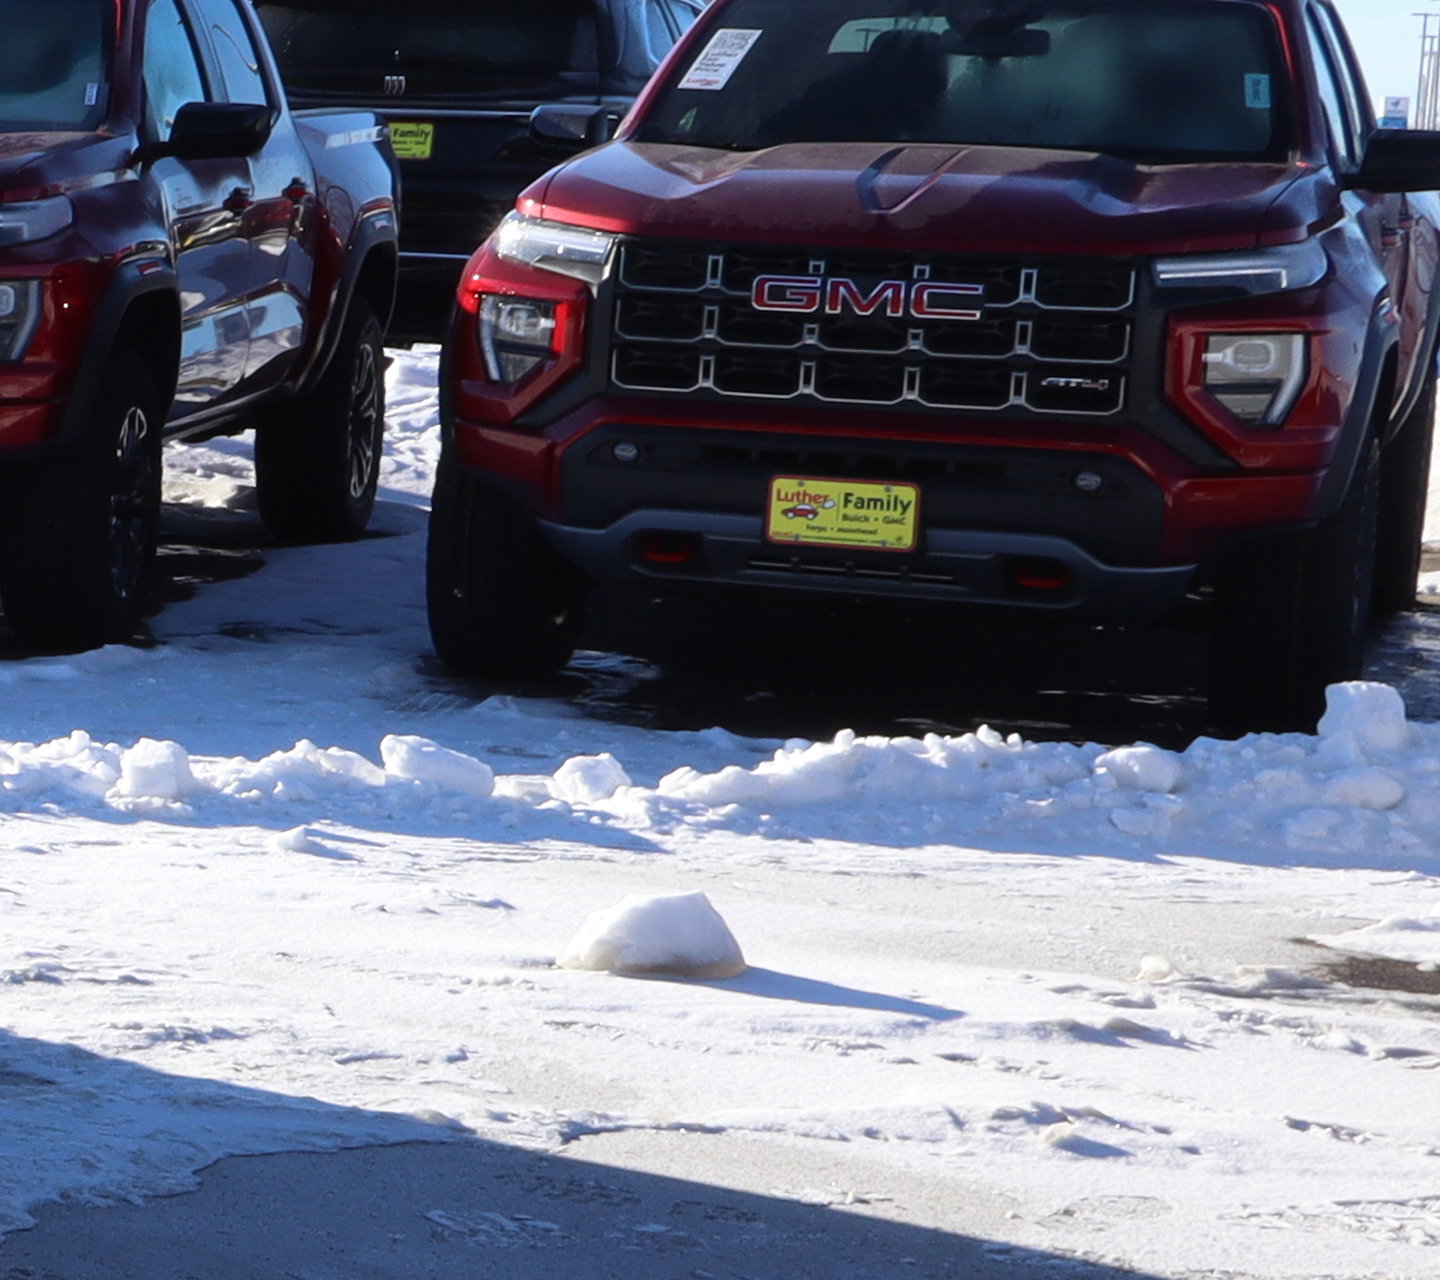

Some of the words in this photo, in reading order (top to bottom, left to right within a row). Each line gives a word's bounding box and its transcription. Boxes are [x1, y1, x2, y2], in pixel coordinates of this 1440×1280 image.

[751, 274, 984, 320] GMC
[776, 488, 831, 504] Luther
[843, 492, 912, 516] Family
